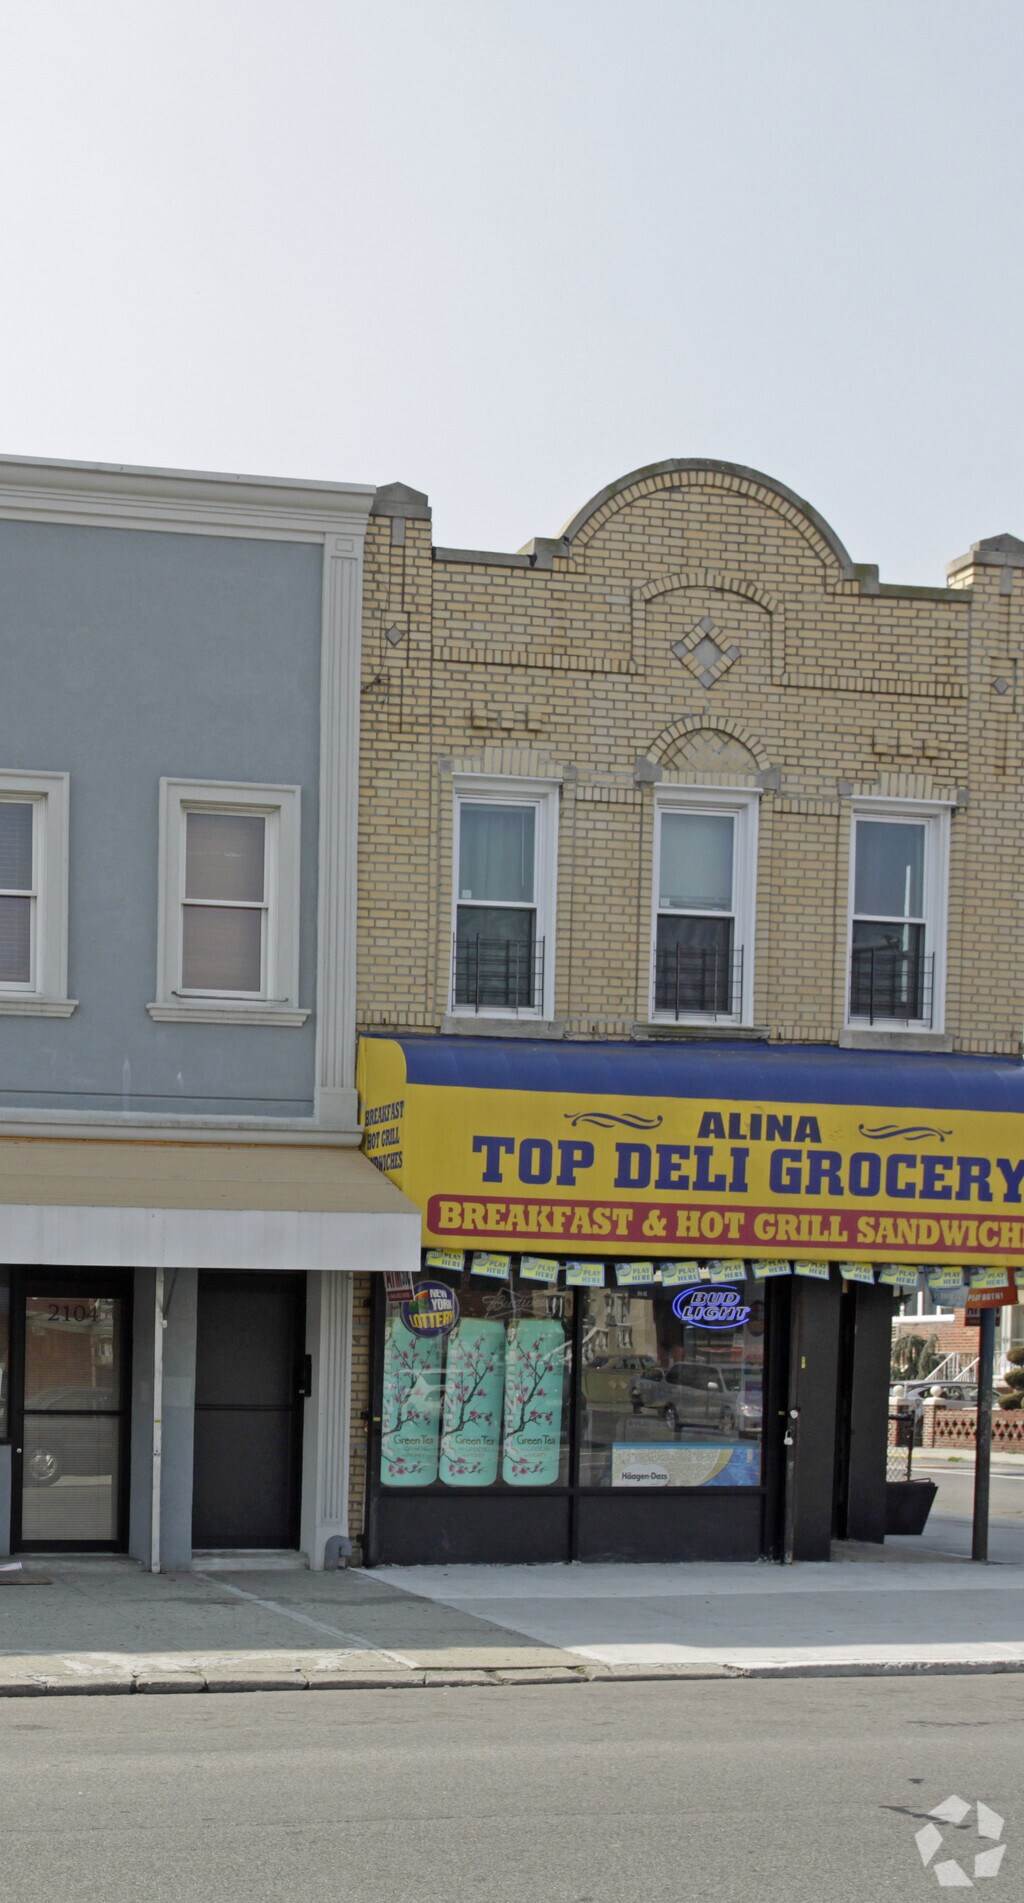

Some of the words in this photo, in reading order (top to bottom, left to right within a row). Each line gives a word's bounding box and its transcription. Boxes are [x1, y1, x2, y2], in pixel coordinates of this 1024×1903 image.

[365, 1100, 404, 1127] BREAKFAST
[697, 1111, 822, 1143] ALINA
[367, 1131, 380, 1150] HOT
[381, 1126, 400, 1147] GRILL
[472, 1135, 595, 1186] TOP
[614, 1142, 750, 1193] DELI
[769, 1148, 1024, 1204] GROCERY
[438, 1201, 634, 1236] BREAKFAST
[642, 1209, 667, 1237] &
[676, 1210, 745, 1239] HOT
[753, 1213, 849, 1242] GRILL
[443, 1252, 462, 1261] PLAY
[441, 1258, 461, 1268] HERE
[488, 1260, 507, 1269] PLAY
[724, 1263, 742, 1272] PLAY
[486, 1267, 506, 1276] HERE
[537, 1264, 555, 1273] PLAY
[583, 1269, 601, 1277] PLAY
[632, 1266, 650, 1275] PLAY
[678, 1265, 696, 1275] PLAY
[768, 1265, 788, 1273] HERE
[808, 1267, 827, 1276] HERE
[855, 1265, 871, 1274] PLAY
[535, 1270, 554, 1279] HERE
[632, 1273, 650, 1282] HERE
[677, 1273, 697, 1282] HERE
[724, 1270, 743, 1279] HERE
[853, 1272, 871, 1281] HERE
[897, 1269, 916, 1278] PLAY
[987, 1271, 1006, 1279] PLAY
[582, 1276, 601, 1284] HERE
[896, 1276, 916, 1285] HERE
[942, 1278, 961, 1286] HERE
[986, 1278, 1006, 1286] HERE
[429, 1288, 448, 1299] NEW
[690, 1292, 740, 1307] BUD
[431, 1299, 453, 1311] YORK
[48, 1304, 100, 1323] 2104
[681, 1306, 751, 1321] LIGHT
[409, 1311, 454, 1329] LOTTERY
[394, 1435, 421, 1445] Green
[421, 1435, 434, 1445] Tea
[455, 1435, 481, 1445] Green
[481, 1435, 495, 1446] Tea
[517, 1435, 542, 1445] Green
[542, 1435, 556, 1445] Tea
